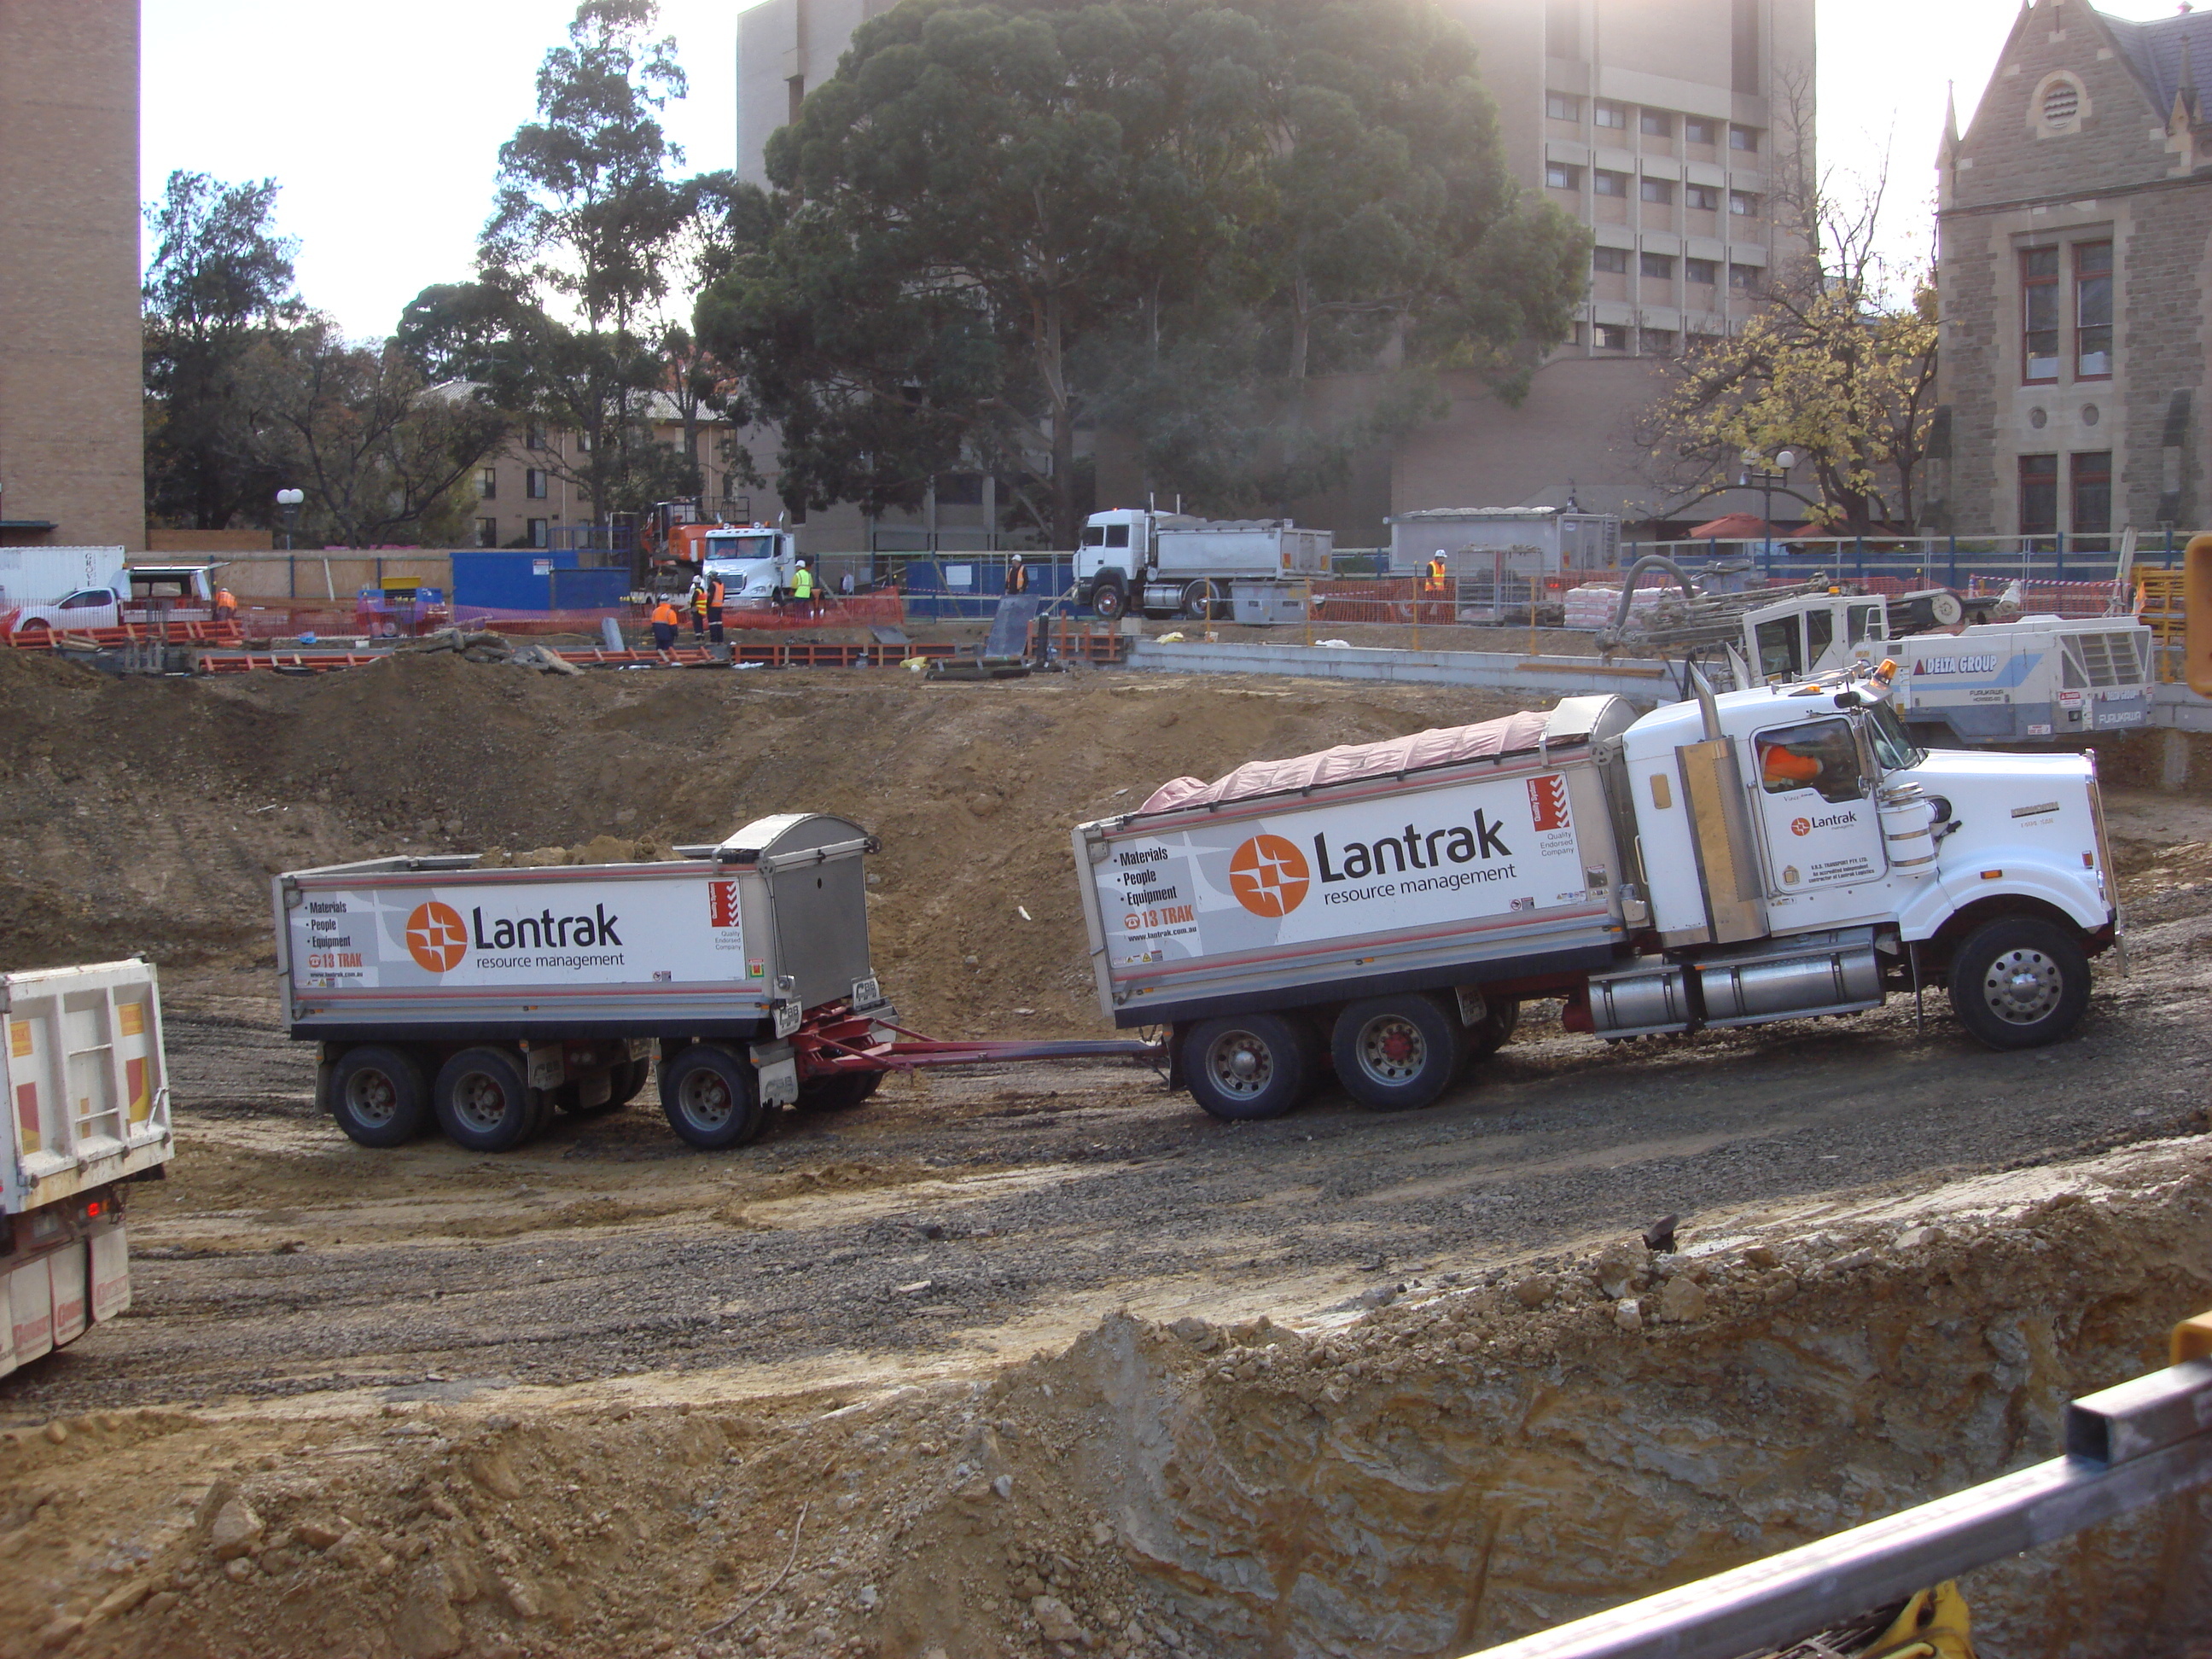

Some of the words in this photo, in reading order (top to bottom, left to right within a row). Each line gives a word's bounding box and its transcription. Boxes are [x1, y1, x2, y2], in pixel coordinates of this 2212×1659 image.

[1925, 657, 1956, 674] DELTA
[1958, 655, 1997, 673] GROUP
[2098, 711, 2141, 724] FURUKAWA
[1811, 811, 1857, 829] Lantrak
[1540, 839, 1573, 849] Endorsed
[1547, 831, 1572, 841] Quality
[1313, 807, 1513, 883] Lantrak
[1541, 847, 1575, 857] Company
[1120, 847, 1168, 866] Materials
[1123, 869, 1156, 886] People
[1324, 882, 1395, 905] resource
[1400, 864, 1516, 894] management
[1126, 886, 1177, 906] Equipment
[310, 901, 346, 913] Materials
[1142, 910, 1159, 928] 13
[1161, 905, 1195, 925] TRAK
[311, 919, 336, 932] People
[472, 903, 623, 949] Lantrak
[1128, 926, 1196, 941] www.lantrak.com.au
[312, 936, 351, 949] Equipment
[323, 954, 335, 968] 13
[337, 953, 363, 968] TRAK
[476, 957, 532, 969] resource
[536, 952, 625, 970] management
